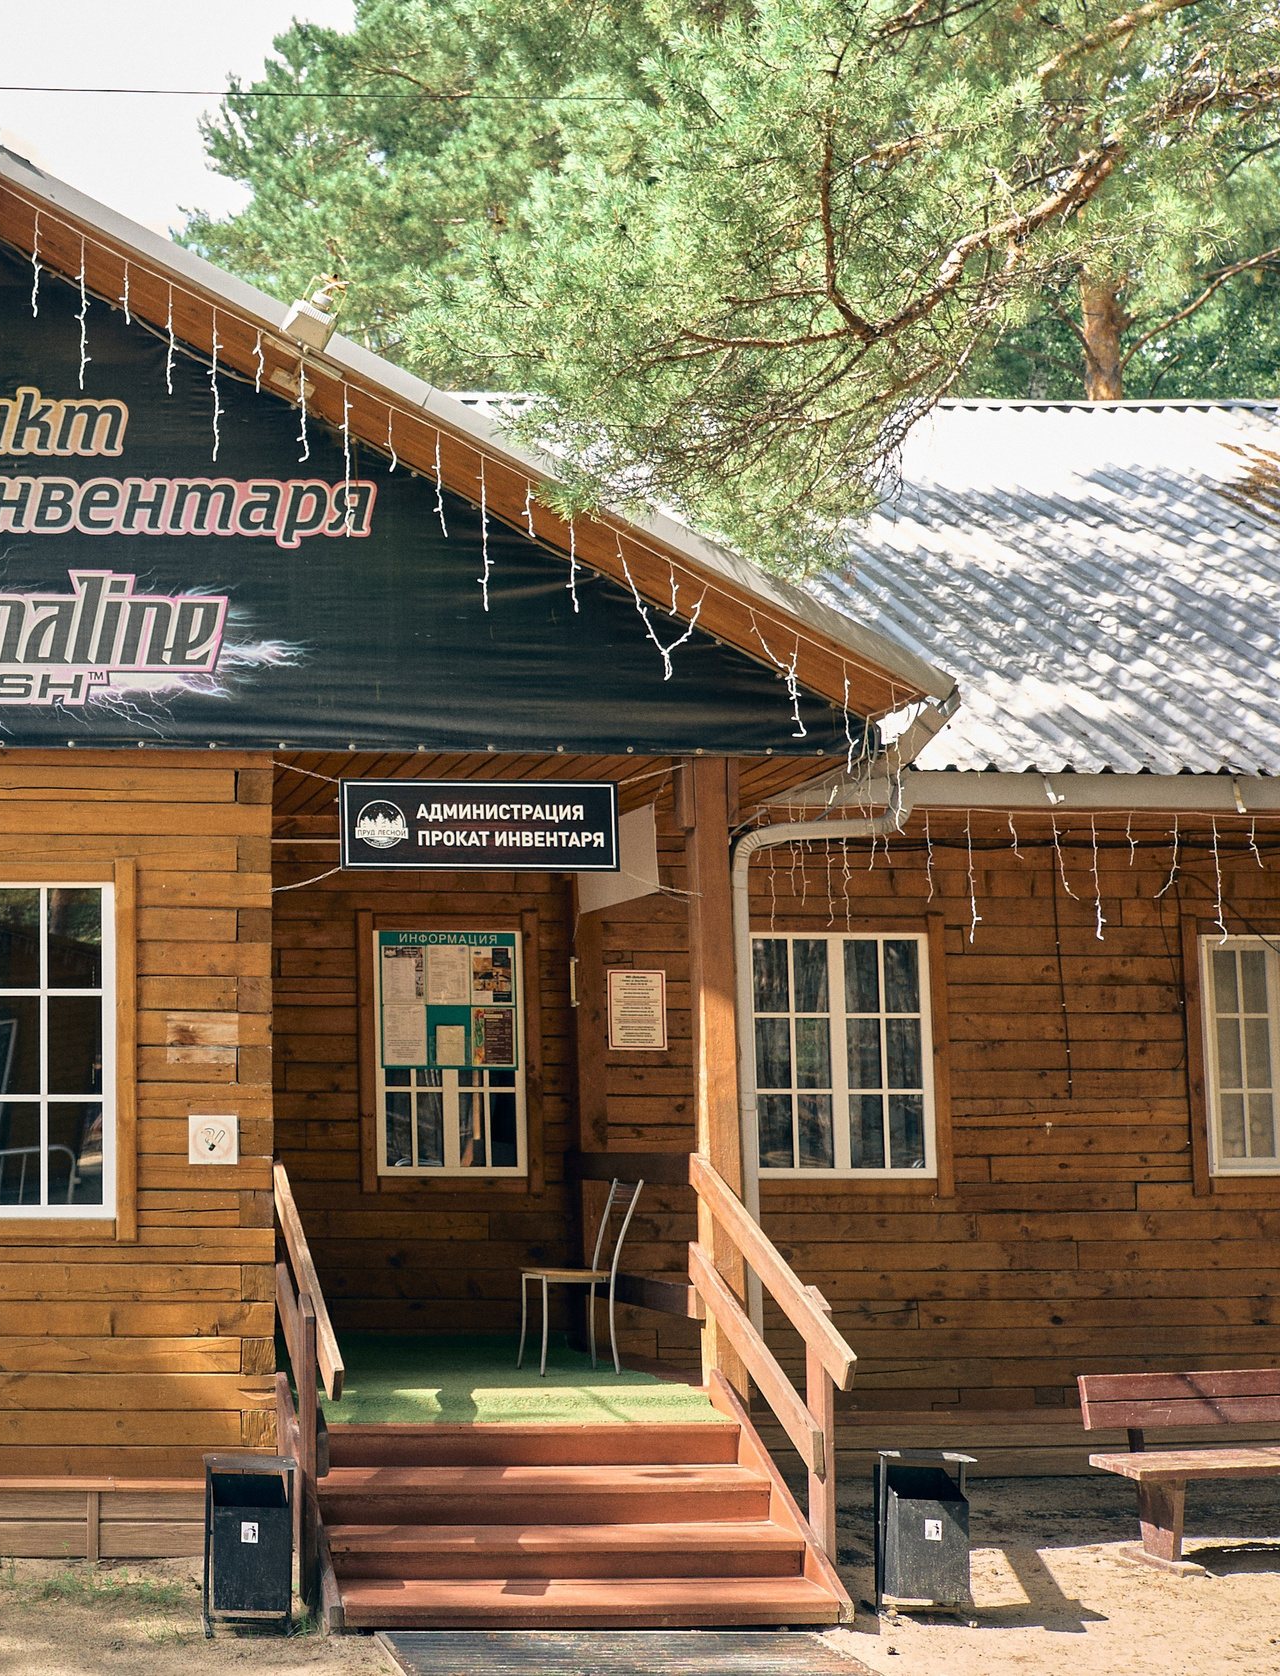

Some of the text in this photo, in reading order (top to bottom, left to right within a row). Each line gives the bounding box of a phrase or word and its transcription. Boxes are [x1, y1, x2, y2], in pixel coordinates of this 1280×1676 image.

[416, 803, 584, 822] АДМИНИСТРАЦИЯ
[357, 829, 376, 837] ПРУД
[417, 830, 489, 847] ПРОКАТ
[494, 831, 605, 848] ИНВЕНТАРЯ
[398, 933, 498, 946] ИНФОРМАЦИЯ
